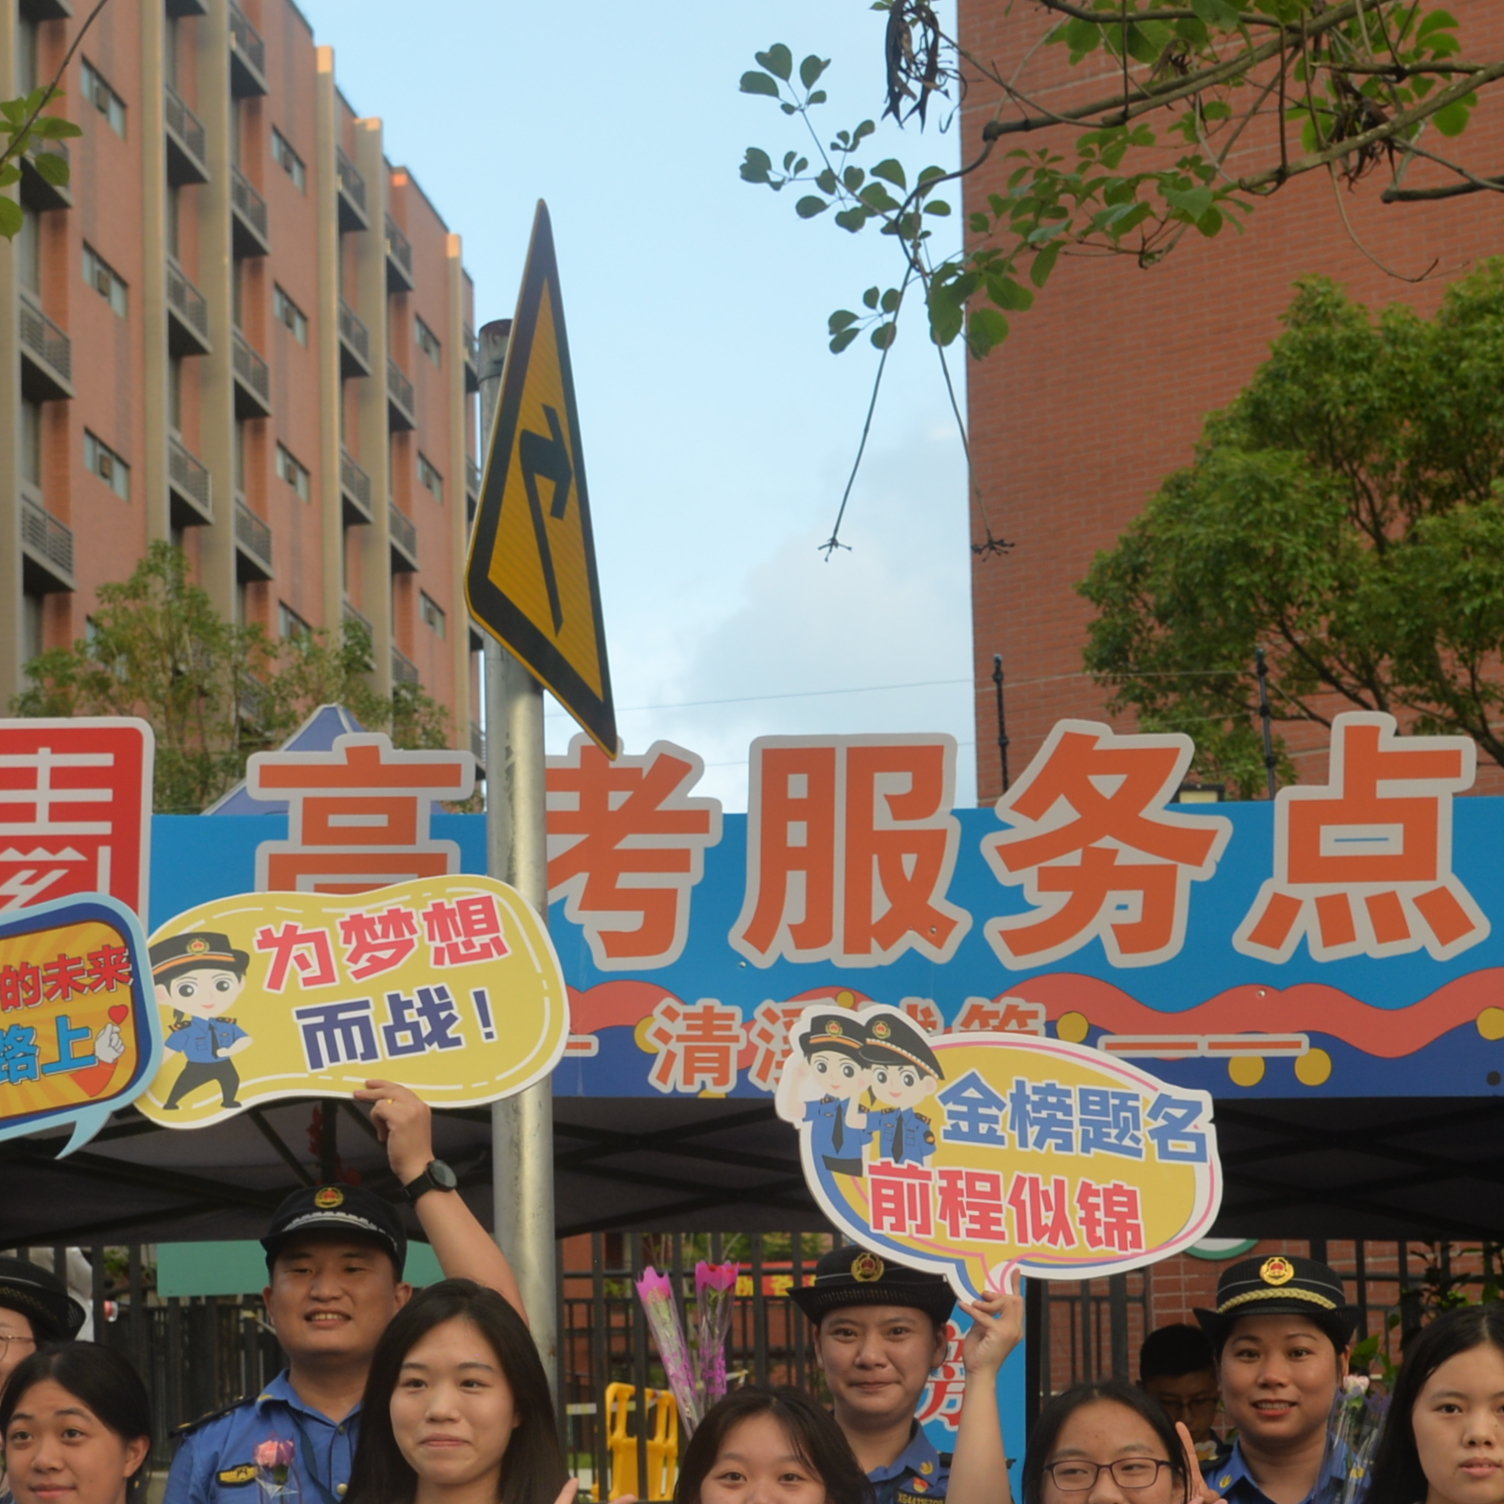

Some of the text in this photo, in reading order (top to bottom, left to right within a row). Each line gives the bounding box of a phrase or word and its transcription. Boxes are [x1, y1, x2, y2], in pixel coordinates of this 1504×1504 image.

[258, 723, 1477, 960] 高考服务点
[255, 893, 509, 992] 为梦想
[936, 1069, 1211, 1166] 金榜题名
[866, 1160, 1144, 1255] 前程似锦
